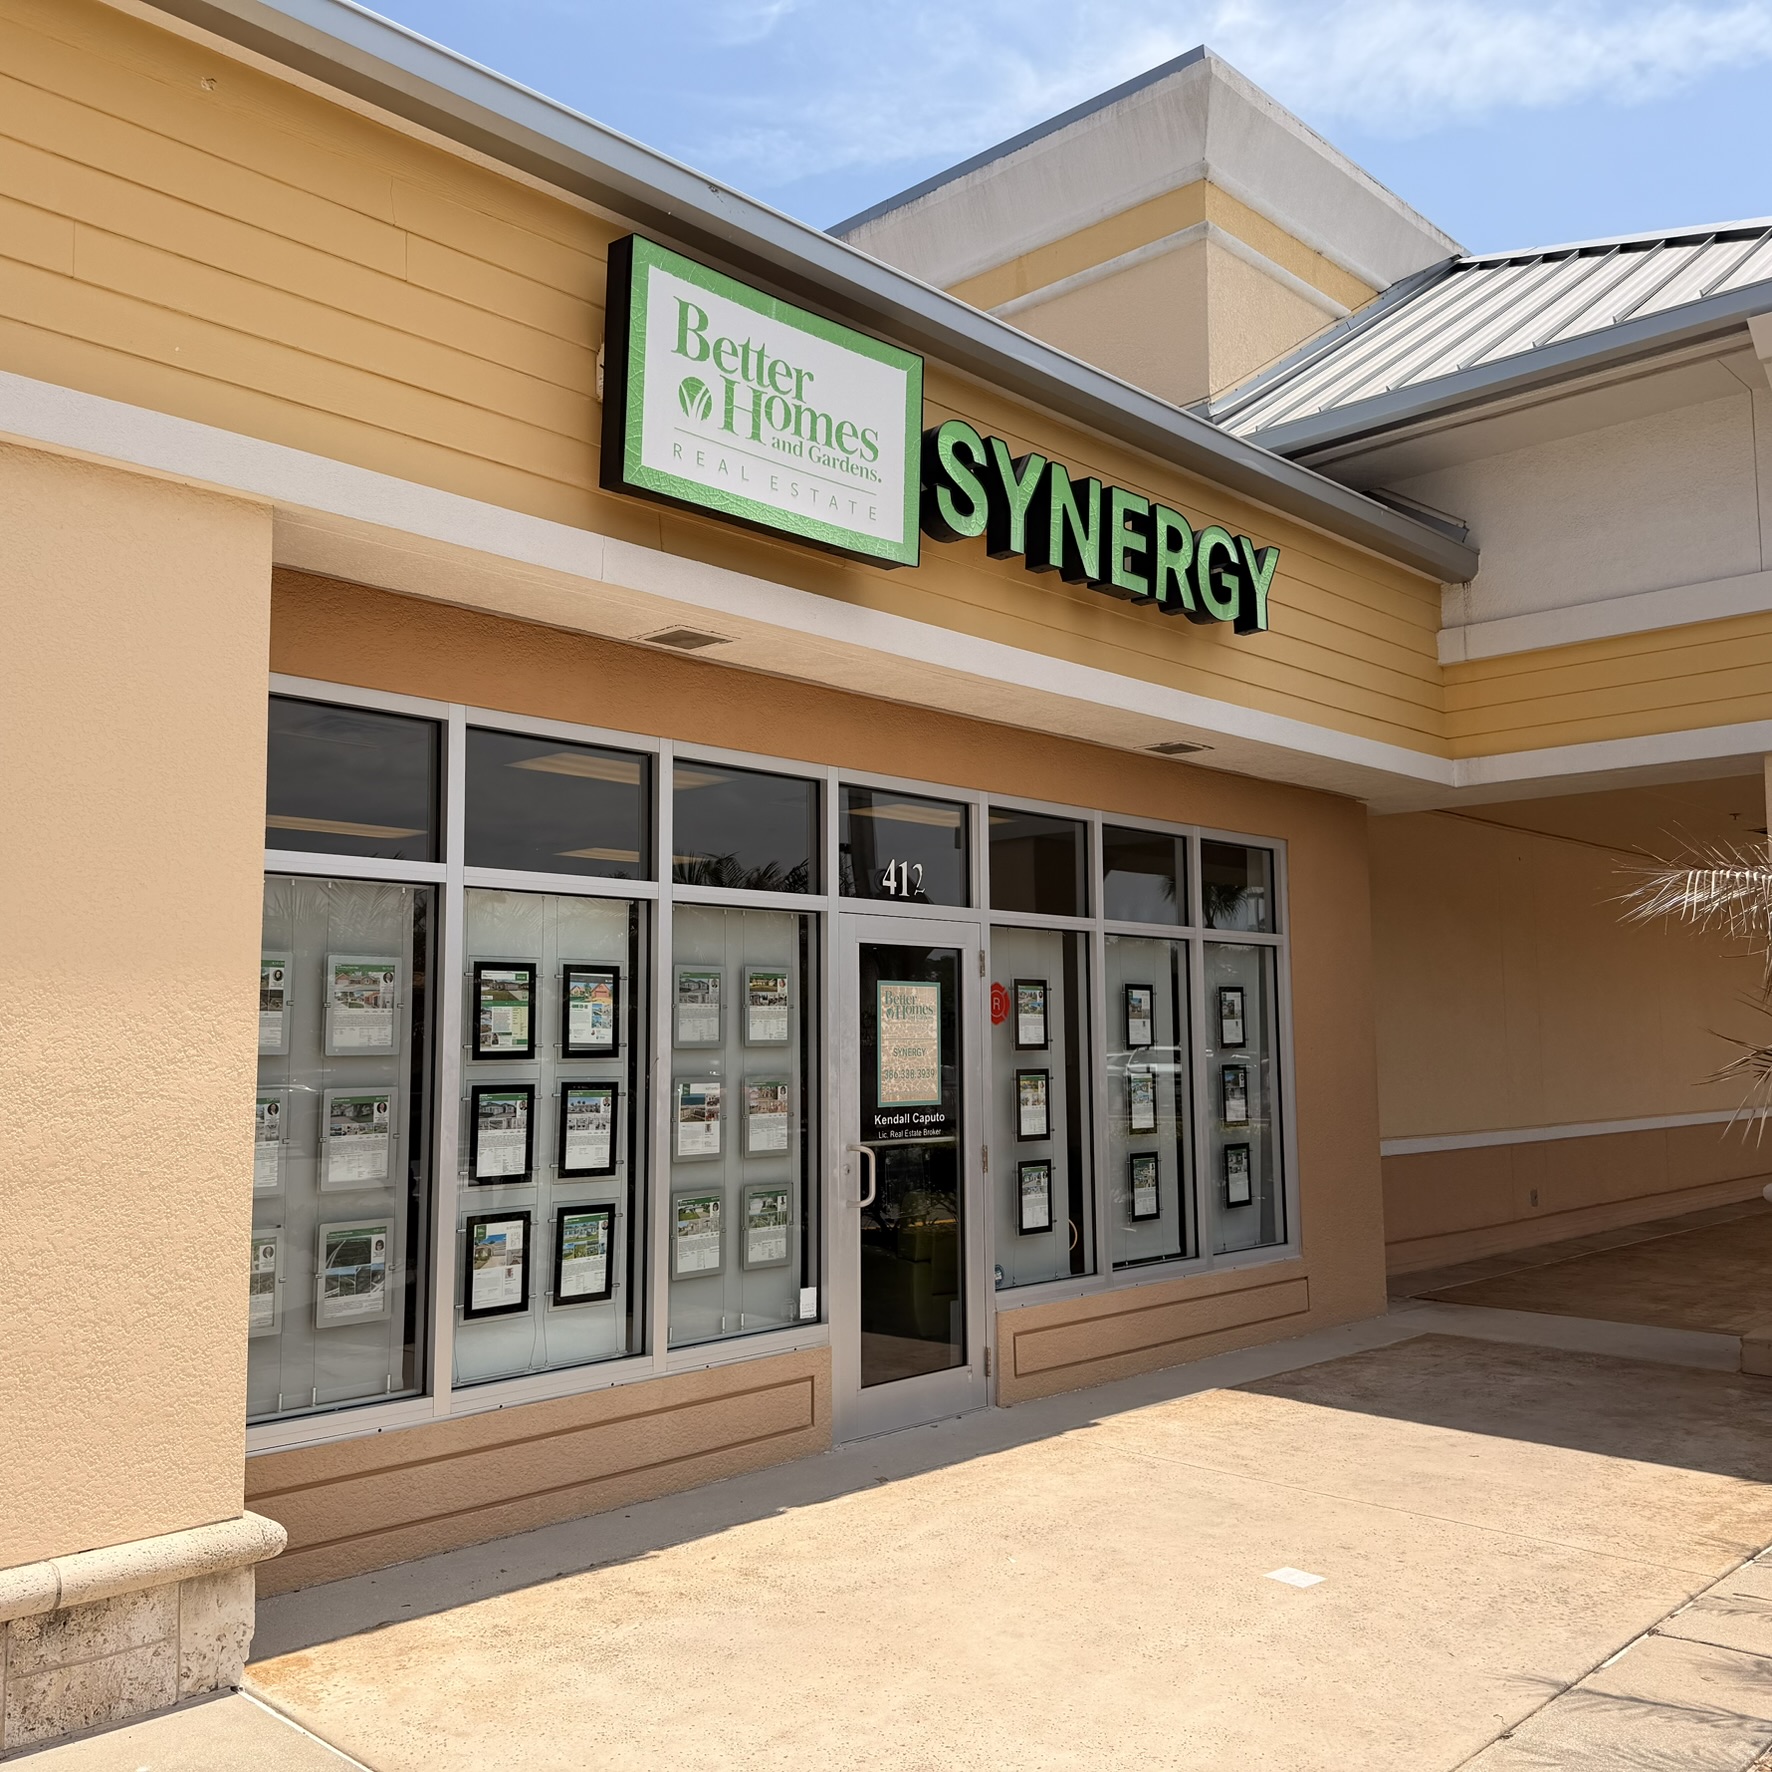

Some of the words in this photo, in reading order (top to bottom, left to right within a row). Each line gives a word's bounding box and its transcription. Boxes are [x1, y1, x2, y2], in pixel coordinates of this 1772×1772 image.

[671, 296, 814, 403] Better
[718, 374, 879, 463] Homes
[771, 435, 803, 457] and
[808, 446, 882, 483] Gardens.
[673, 443, 749, 482] REAL
[770, 475, 877, 521] ESTATE
[936, 419, 1281, 631] SYNERGY
[882, 858, 926, 897] 412
[885, 990, 918, 1006] Better
[895, 1004, 934, 1020] Homes
[893, 1047, 927, 1057] SYNERGY
[874, 1113, 910, 1125] Kendall
[912, 1112, 946, 1125] Caputo
[878, 1131, 888, 1139] Lic.
[890, 1129, 903, 1138] Real
[904, 1129, 922, 1138] Estate
[923, 1128, 942, 1136] Broker
